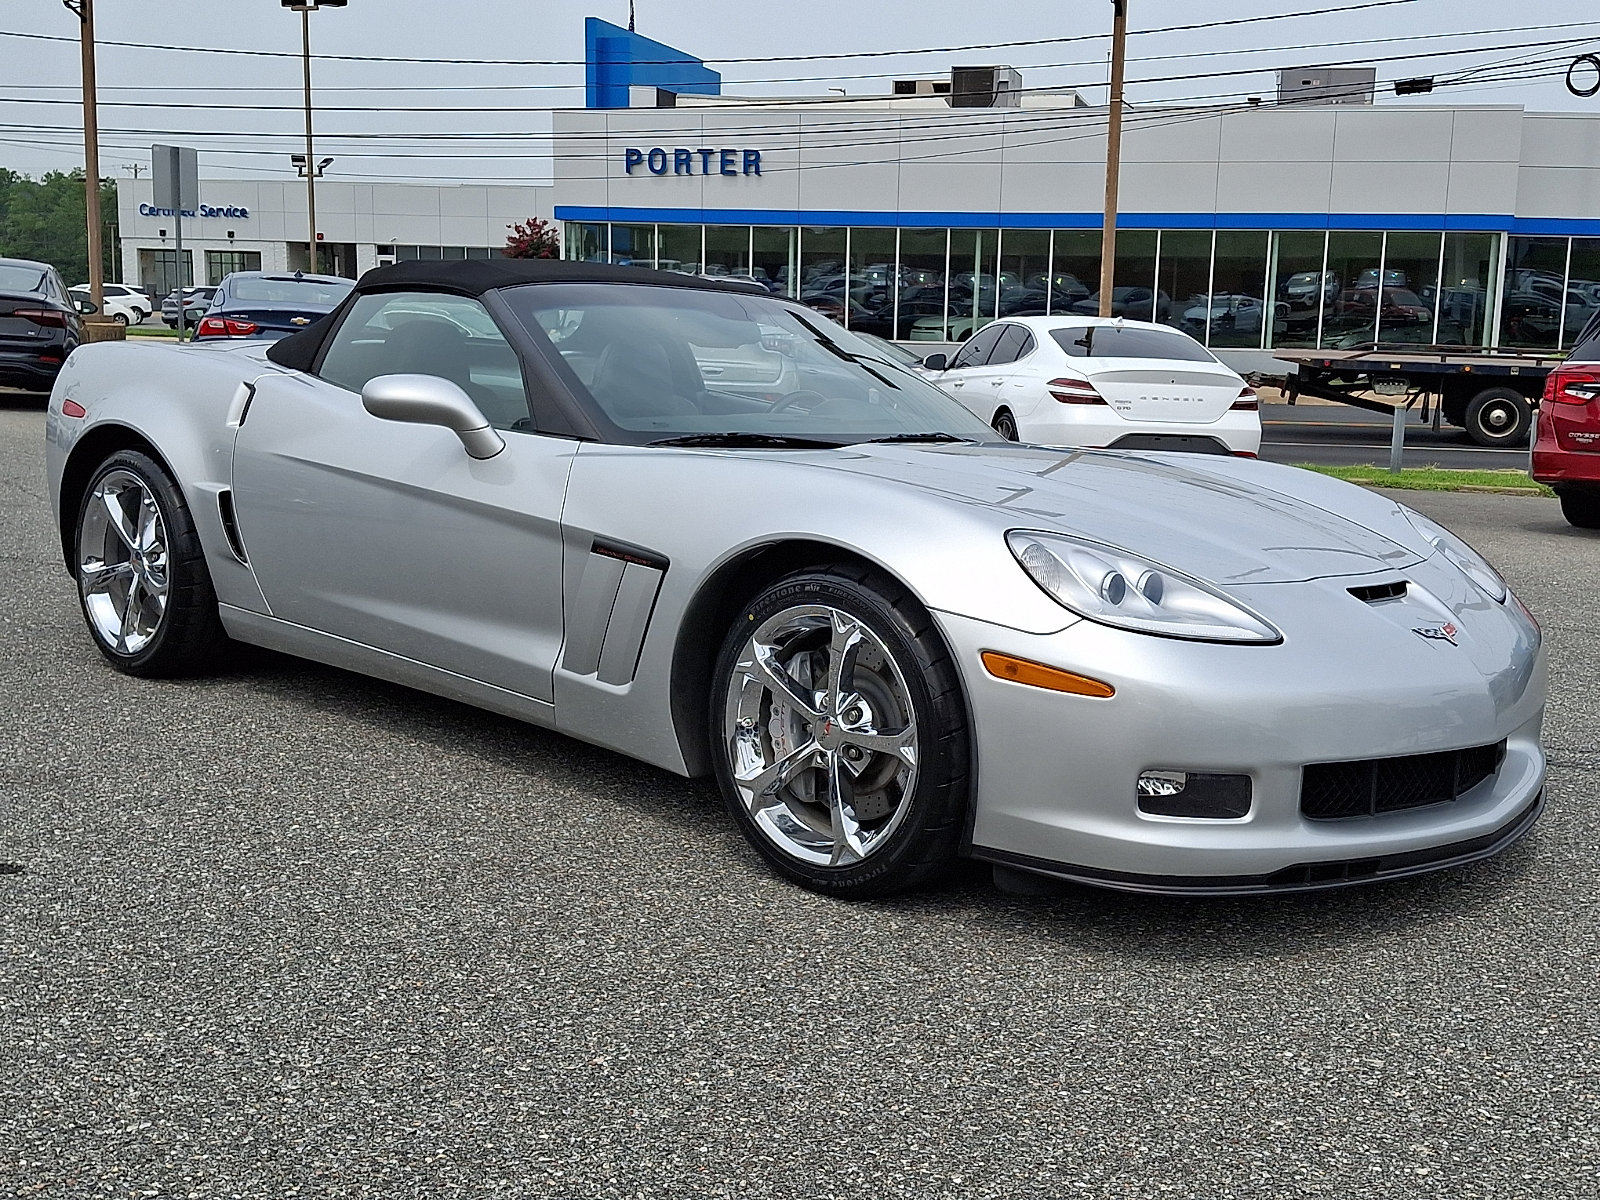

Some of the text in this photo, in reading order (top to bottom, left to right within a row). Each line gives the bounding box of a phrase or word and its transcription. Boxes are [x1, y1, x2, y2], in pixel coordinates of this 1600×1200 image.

[625, 147, 761, 176] PORTER
[139, 203, 249, 218] Certied Service
